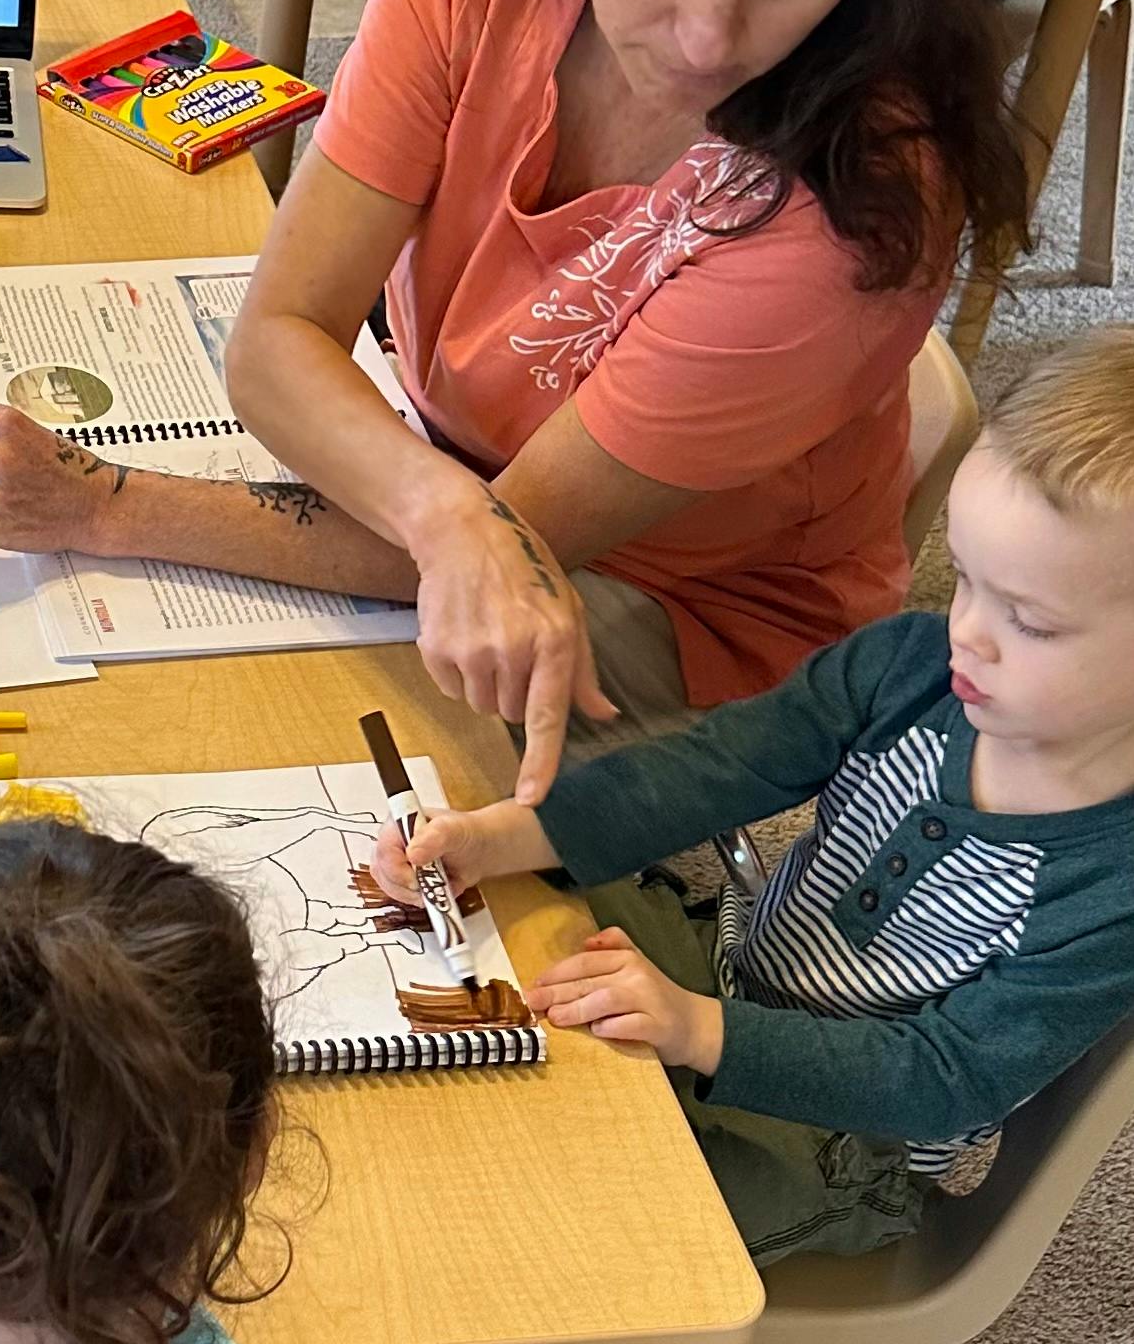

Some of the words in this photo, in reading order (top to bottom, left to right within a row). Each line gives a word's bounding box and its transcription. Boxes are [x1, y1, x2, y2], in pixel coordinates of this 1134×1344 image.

[167, 80, 262, 124] Washable
[177, 80, 229, 106] SUPER
[91, 111, 116, 129] SUPER
[198, 95, 264, 127] Markers
[91, 598, 116, 633] MONGOLIA
